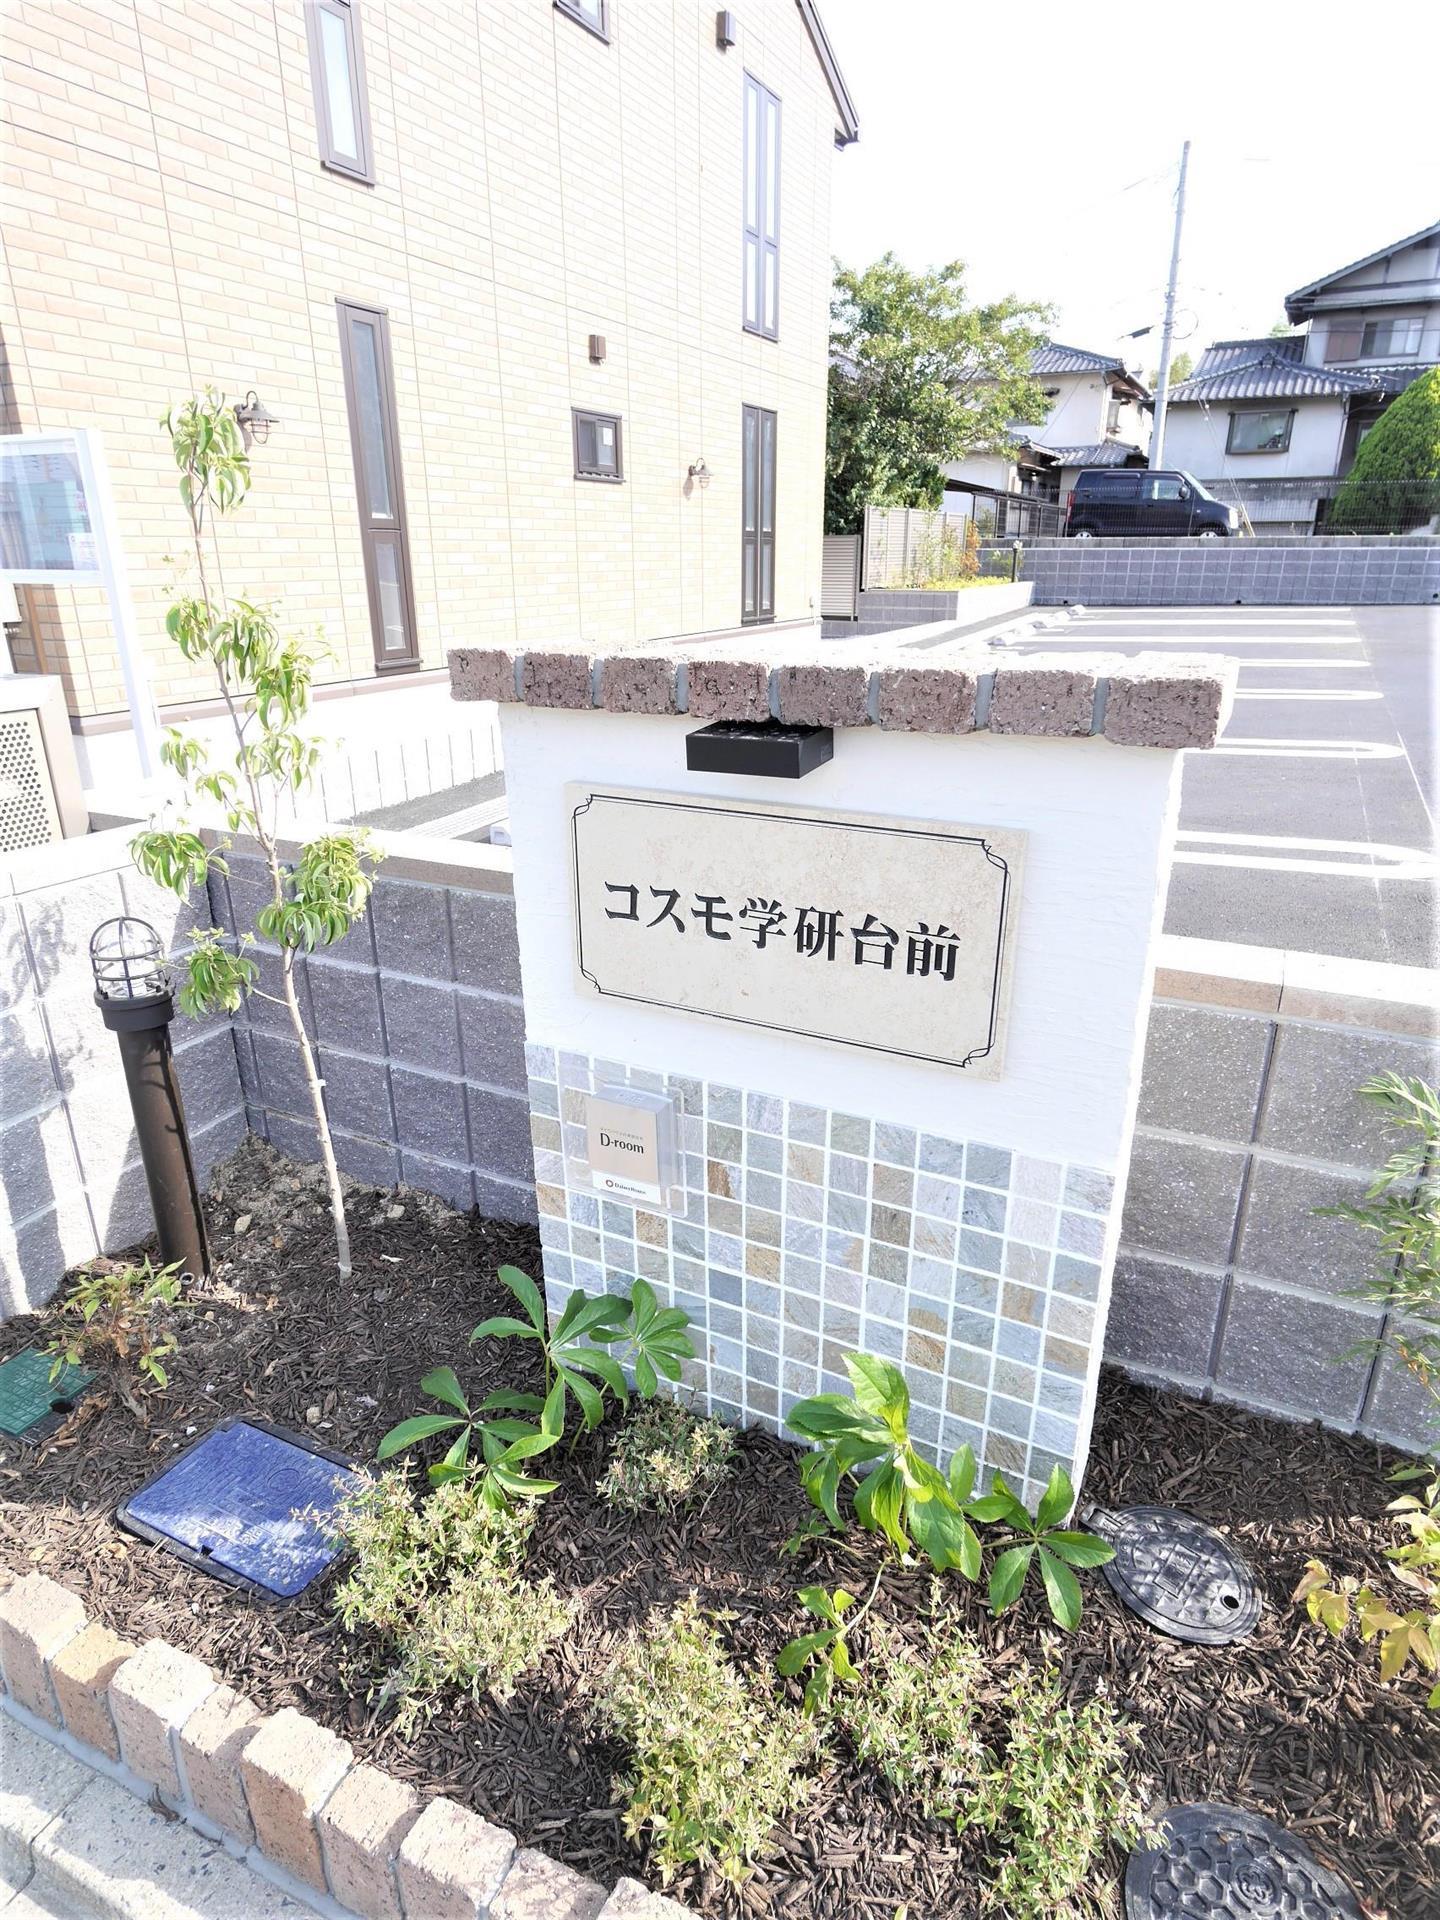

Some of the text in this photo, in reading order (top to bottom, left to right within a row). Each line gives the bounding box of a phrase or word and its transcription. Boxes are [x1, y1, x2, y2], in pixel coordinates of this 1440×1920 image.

[604, 880, 961, 981] コスモ学研台前
[600, 1132, 644, 1154] D-room
